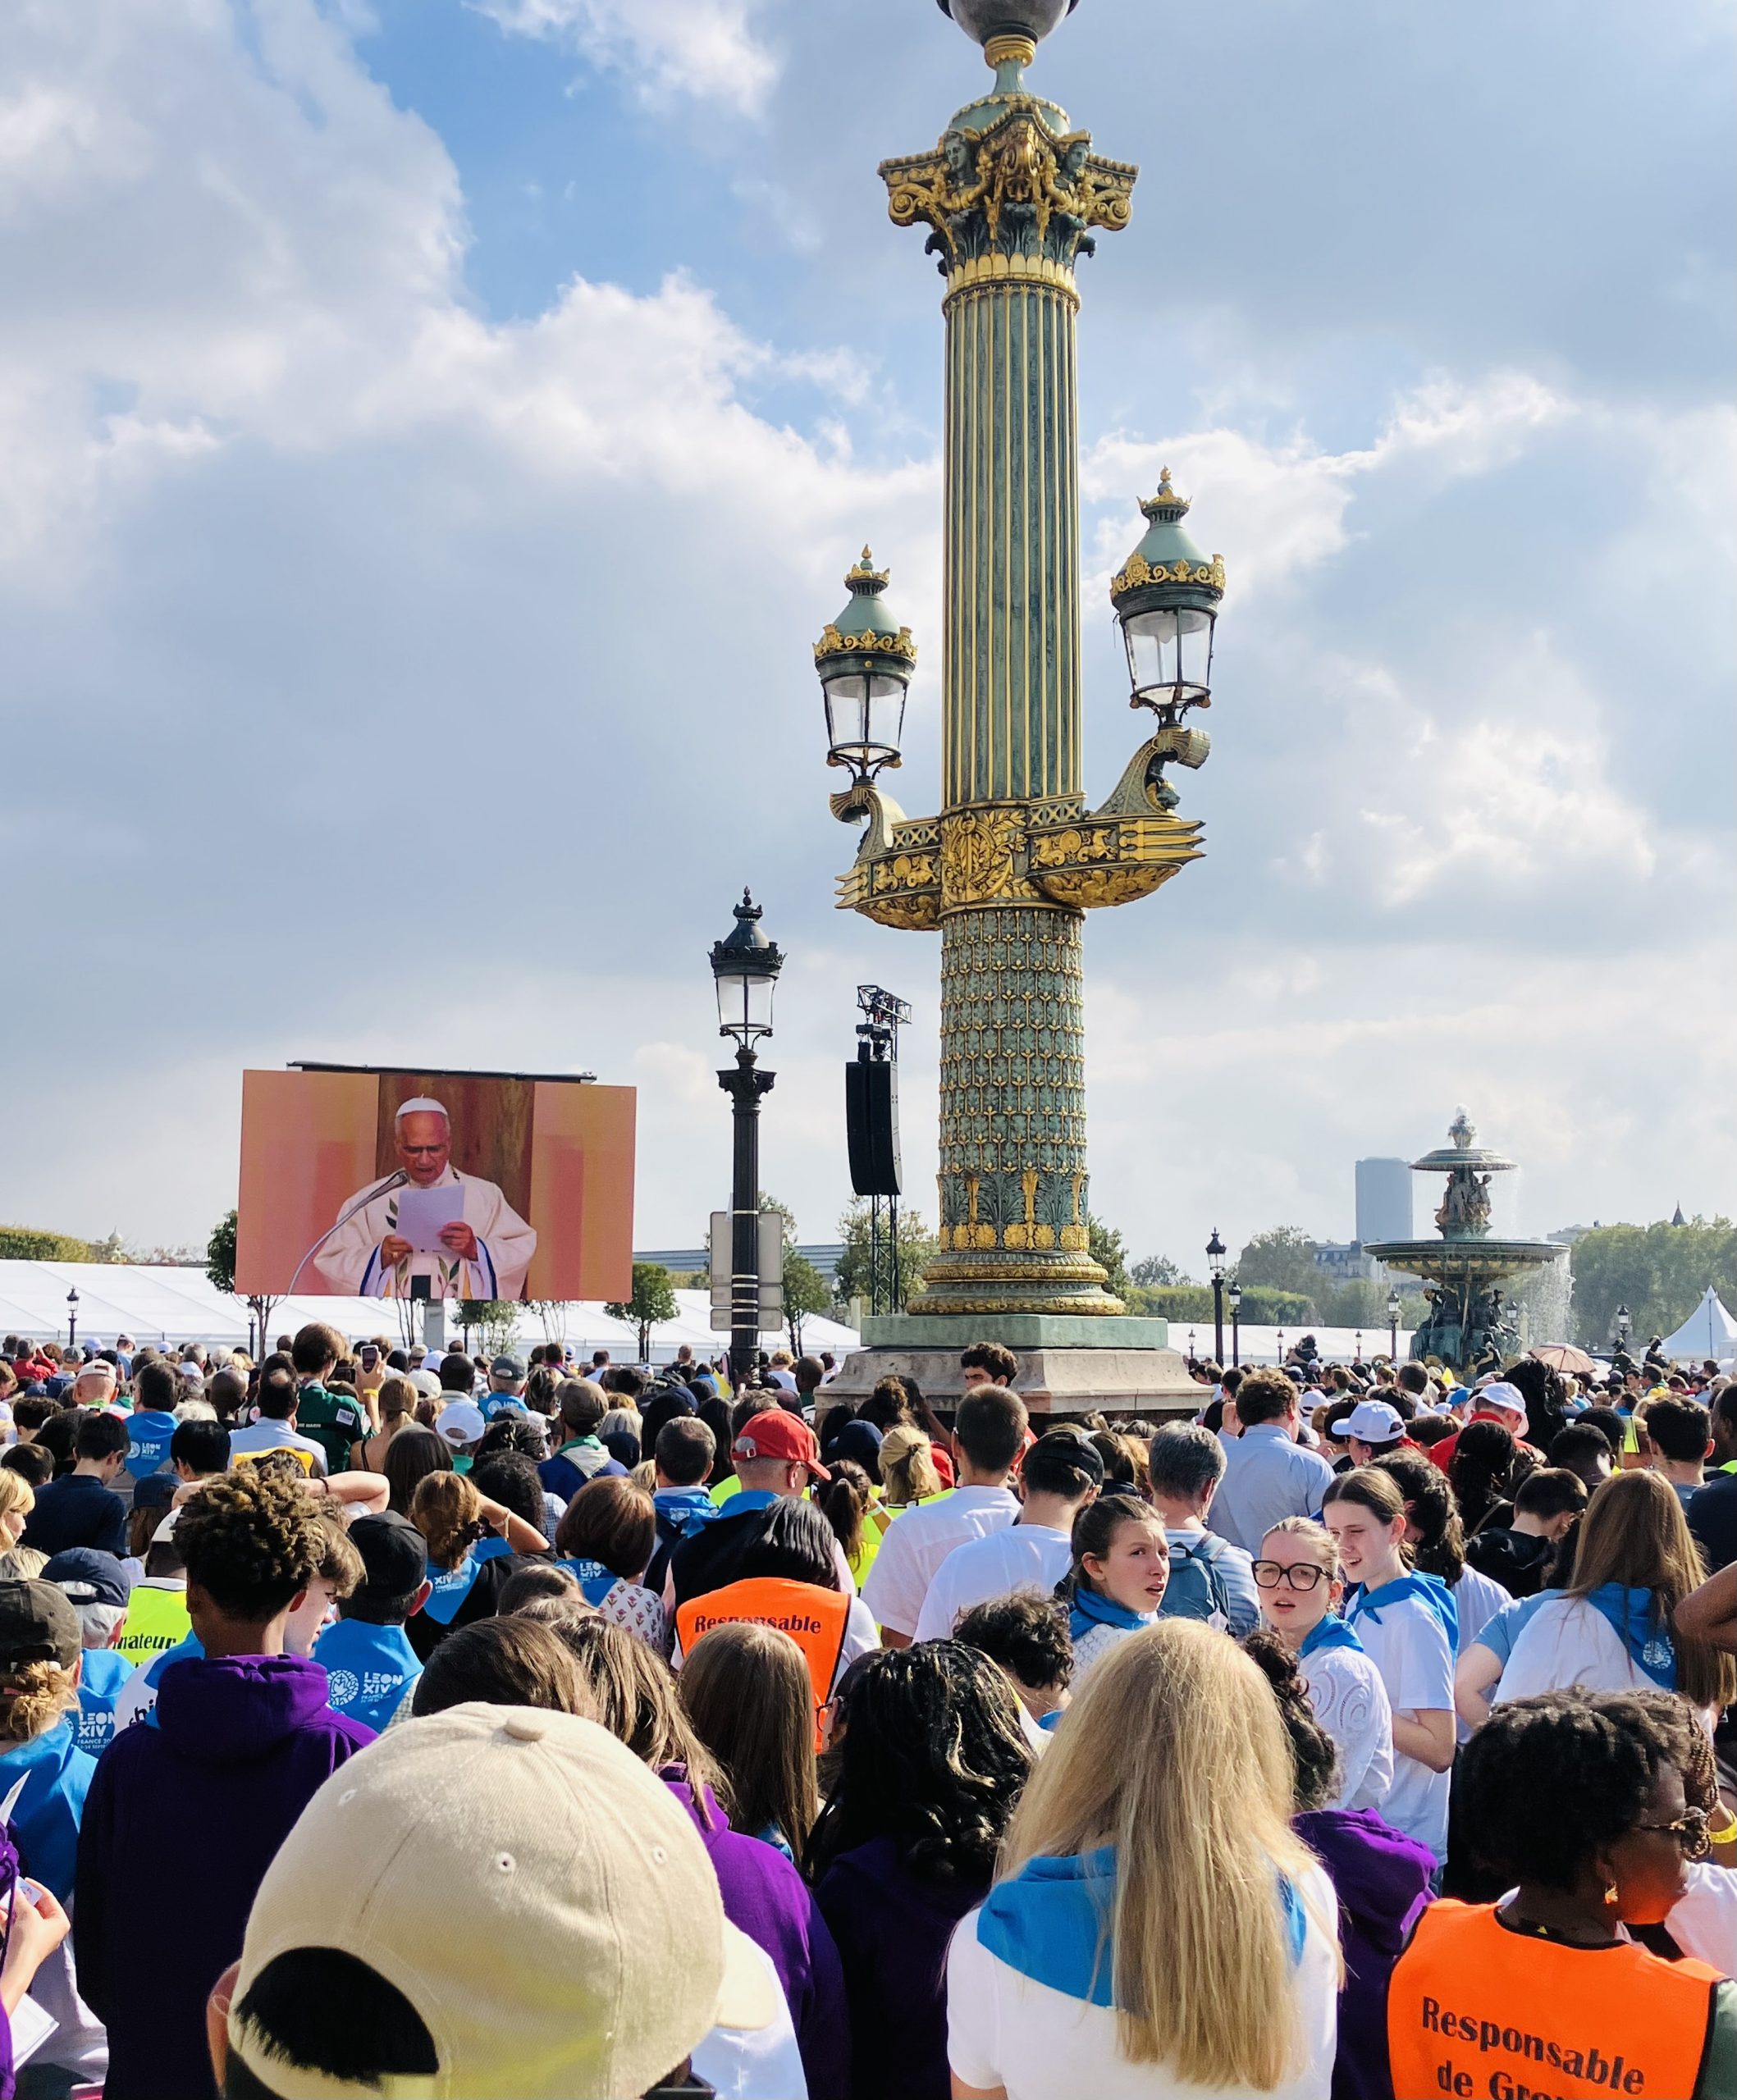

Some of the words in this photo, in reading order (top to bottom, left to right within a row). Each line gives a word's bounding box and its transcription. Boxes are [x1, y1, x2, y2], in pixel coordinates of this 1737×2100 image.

[434, 1574, 453, 1585] XIV
[364, 1672, 403, 1686] LEON
[363, 1683, 391, 1694] XIV
[78, 1724, 107, 1737] XIV
[1421, 1996, 1645, 2096] Responsable
[1437, 2060, 1474, 2098] de
